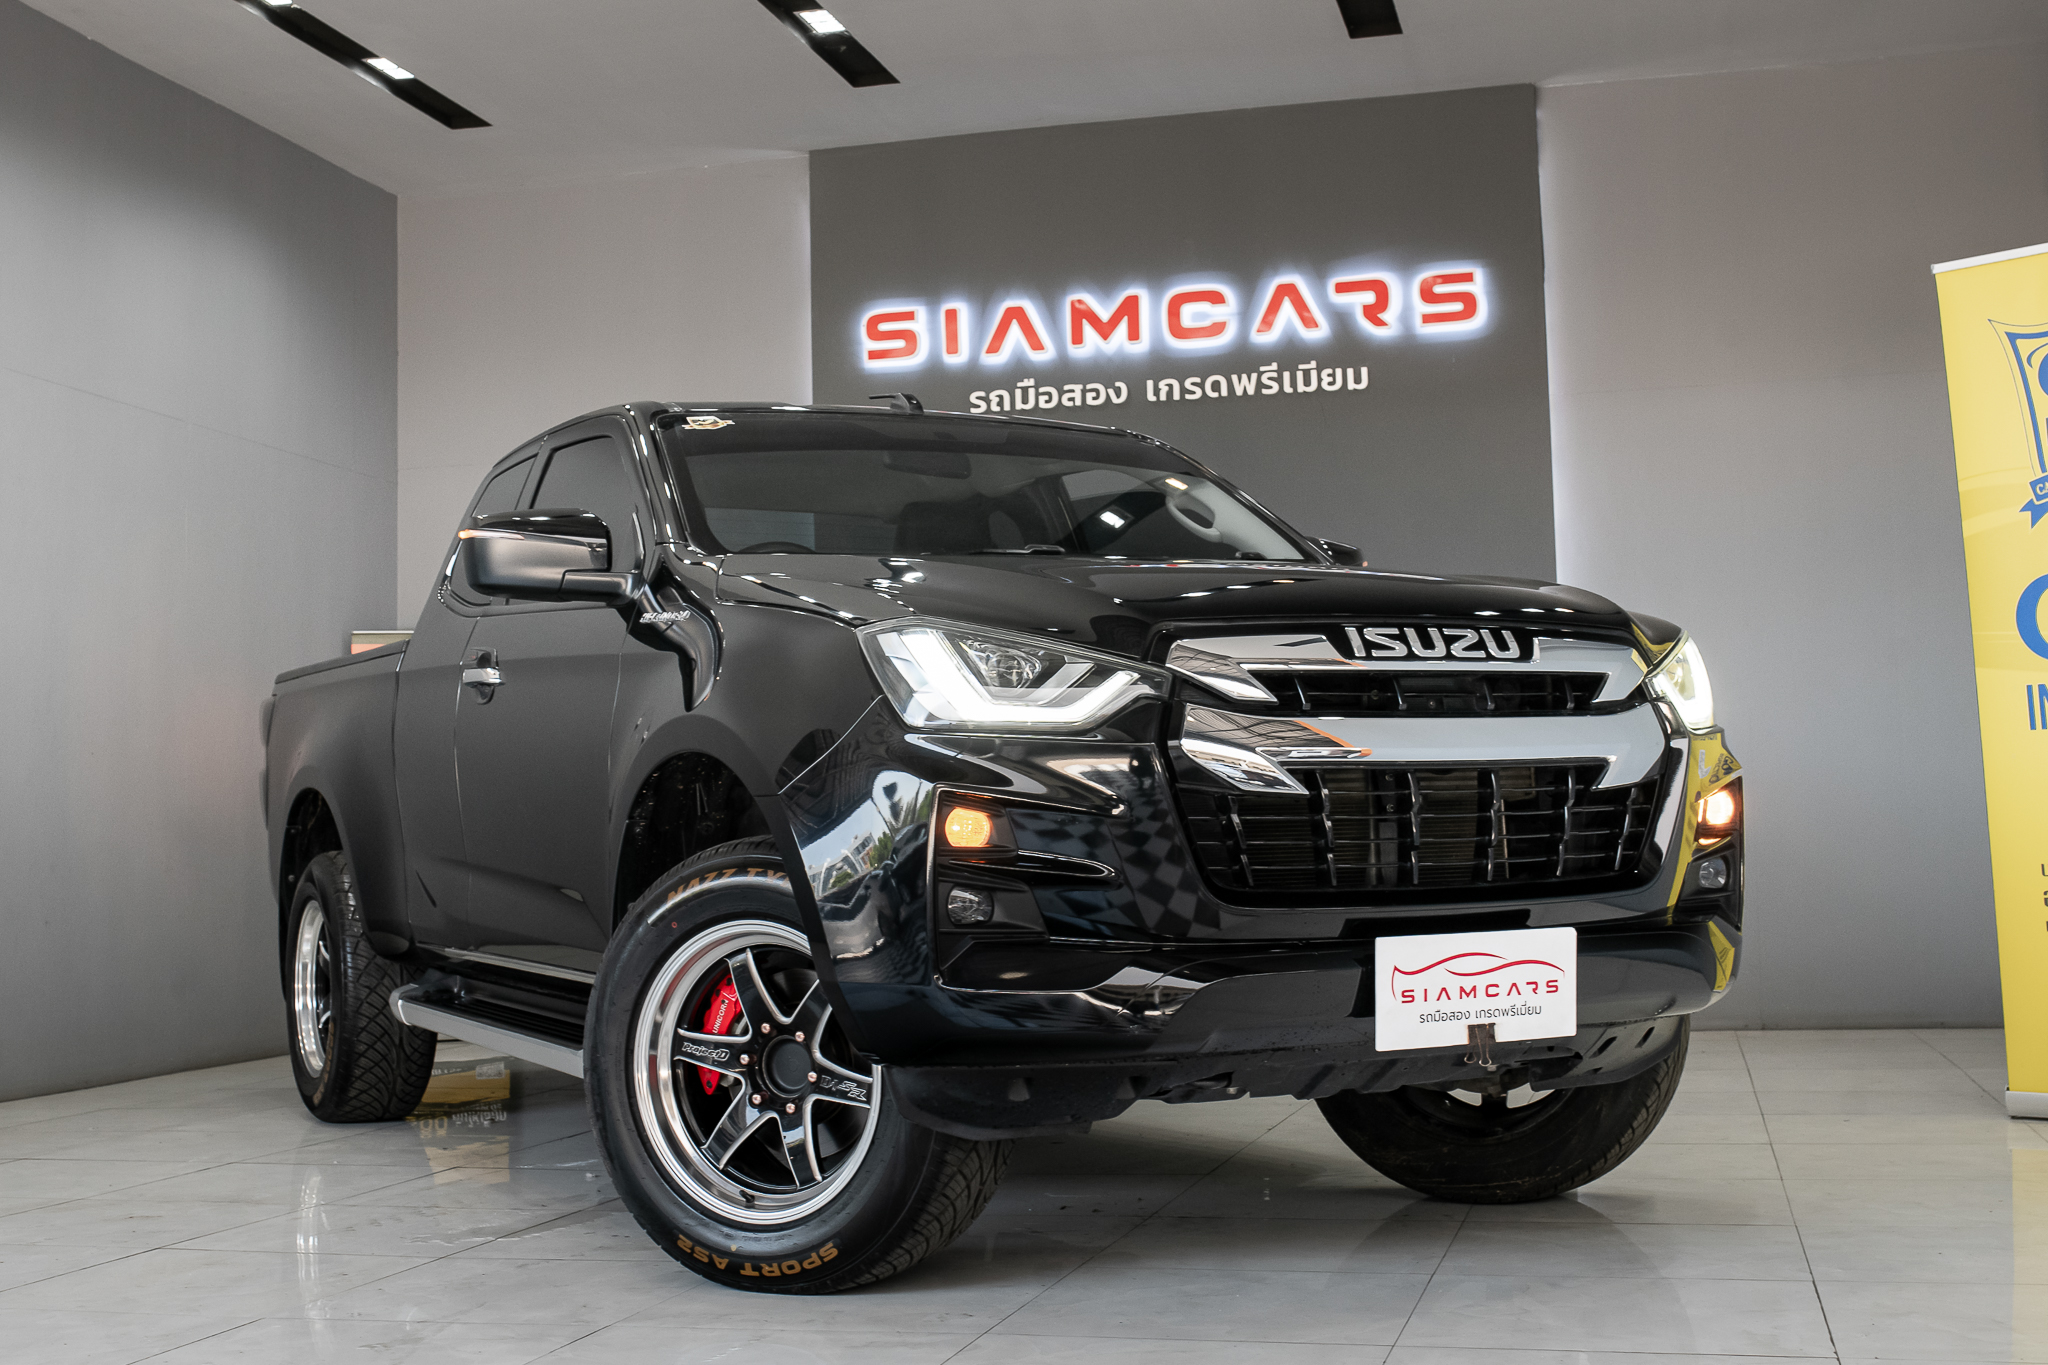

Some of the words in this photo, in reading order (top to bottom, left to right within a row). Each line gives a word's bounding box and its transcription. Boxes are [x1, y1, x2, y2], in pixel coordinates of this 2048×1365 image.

[864, 267, 1484, 364] SIAMCARS
[968, 377, 1128, 414] รถมือสอง
[1344, 626, 1521, 660] ISUZU
[1401, 979, 1559, 1004] SIAMCARS
[712, 998, 729, 1033] UNICORN
[1419, 1010, 1470, 1024] รถมือสอง
[677, 1234, 729, 1269] AS2
[740, 1242, 838, 1276] SPORT
